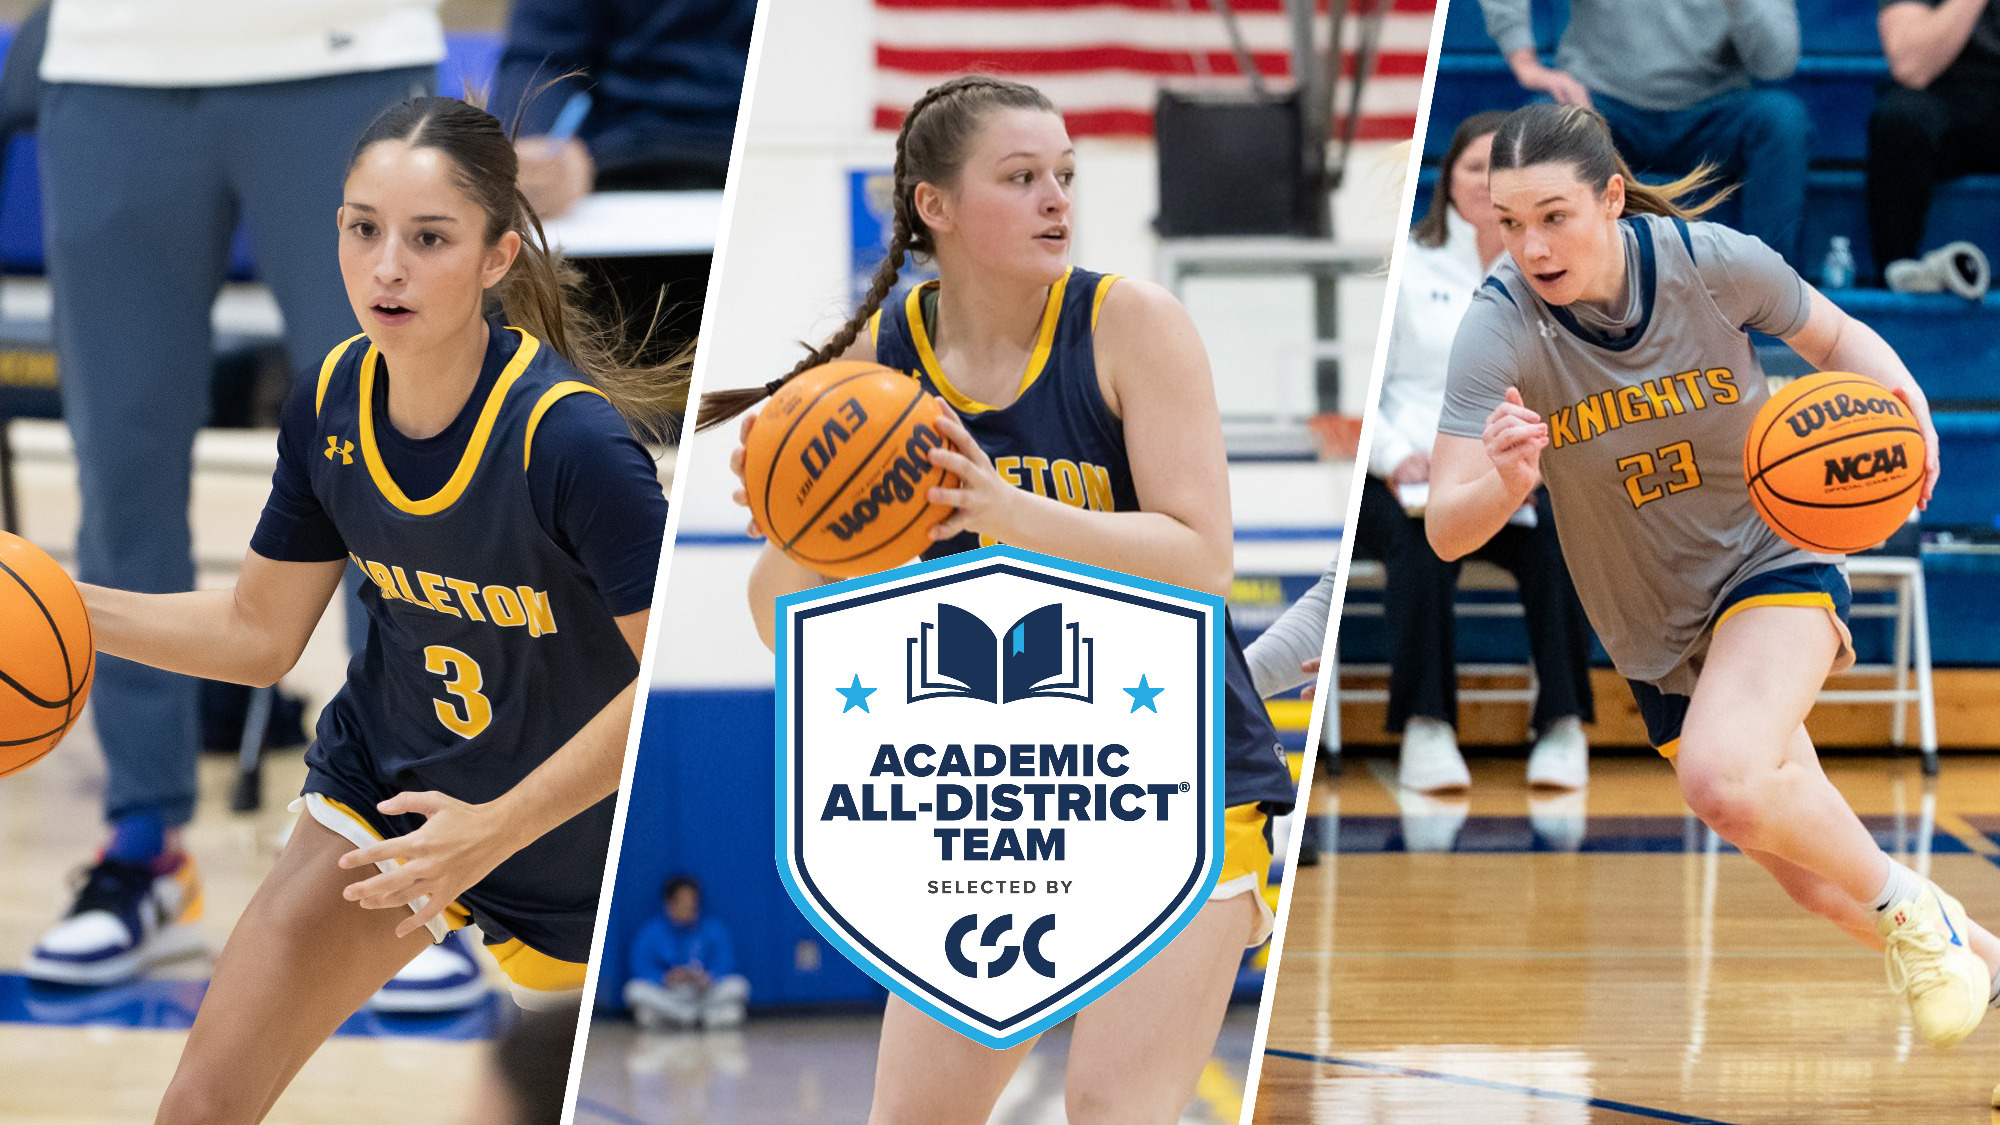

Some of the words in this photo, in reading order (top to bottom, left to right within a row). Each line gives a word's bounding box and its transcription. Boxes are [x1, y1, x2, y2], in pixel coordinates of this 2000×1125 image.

[800, 397, 868, 480] EVO
[1549, 367, 1740, 449] KNIGHTS
[1785, 393, 1904, 438] Wilson
[1616, 439, 1703, 510] 23
[1823, 443, 1908, 486] NCAA
[349, 551, 558, 638] RLETON
[423, 645, 493, 740] 3
